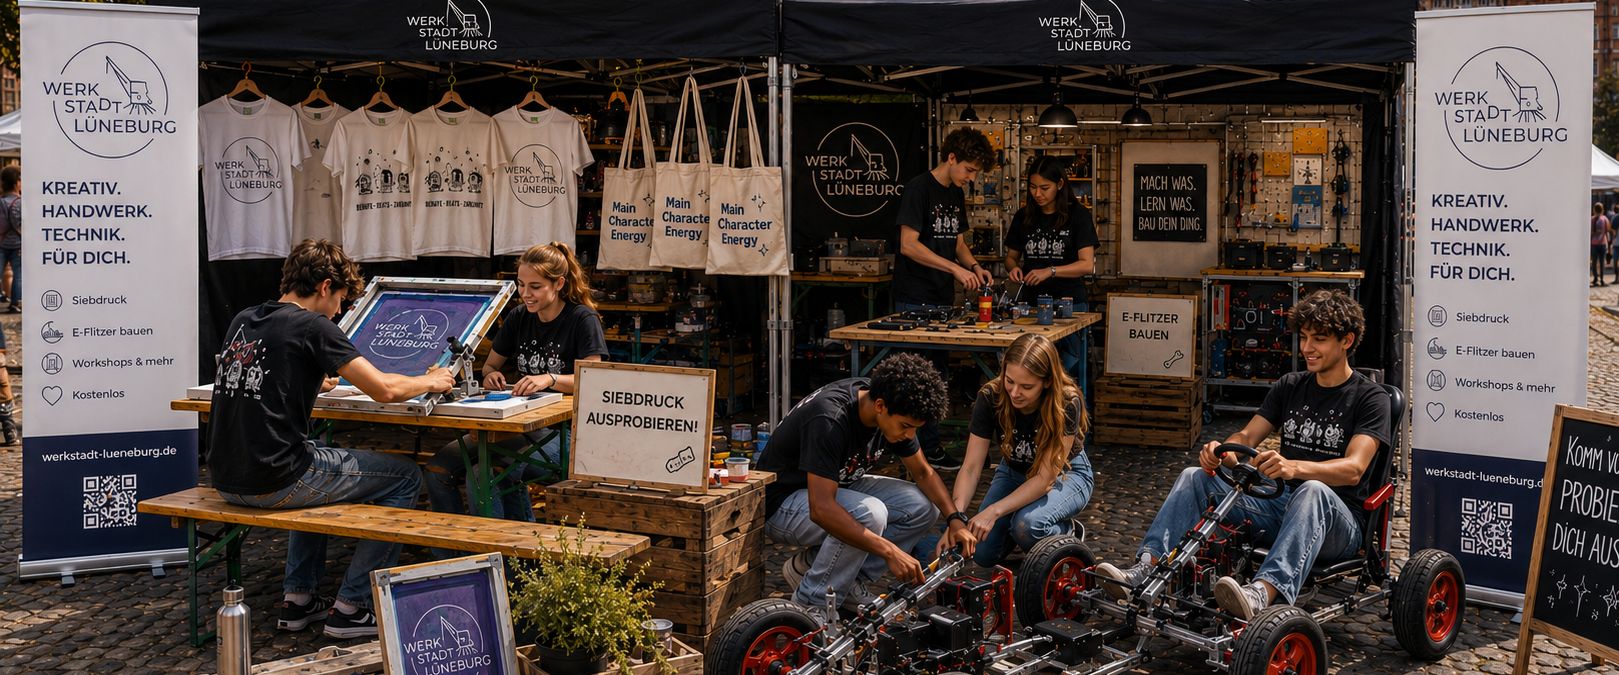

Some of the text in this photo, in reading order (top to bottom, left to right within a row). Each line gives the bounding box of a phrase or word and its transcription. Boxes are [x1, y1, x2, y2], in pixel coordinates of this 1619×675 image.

[406, 16, 445, 26] WERK
[1038, 16, 1078, 27] WERK
[419, 28, 458, 37] STADT
[1051, 28, 1091, 38] STADT
[425, 38, 498, 50] LÜNEBURG
[1057, 39, 1131, 51] LÜNEBURG
[43, 81, 99, 96] WERK
[1435, 91, 1488, 105] WERK
[65, 98, 122, 114] STADT
[1454, 105, 1511, 123] STADT
[74, 116, 176, 134] LÜNEBURG
[1463, 126, 1568, 142] LÜNEBURG
[214, 161, 244, 170] WERK
[805, 155, 847, 167] WERK
[225, 170, 254, 179] STADT
[505, 166, 532, 175] WERK
[820, 169, 863, 180] STADT
[513, 175, 540, 184] STADT
[1140, 175, 1197, 191] MACH WAS.
[42, 181, 121, 195] KREATIV.
[517, 184, 566, 195] LÜNEBURG
[612, 201, 636, 213] Main
[666, 196, 691, 209] Main
[1140, 196, 1195, 212] LERN WAS.
[1432, 194, 1508, 208] KREATIV.
[42, 205, 152, 218] HANDWERK.
[721, 203, 745, 216] Main
[608, 215, 654, 227] Characte
[662, 211, 710, 224] Characte
[718, 217, 772, 230] Character
[1138, 216, 1203, 231] BAU DEIN DING.
[1432, 218, 1539, 232] HANDWERK.
[42, 228, 125, 241] TECHNIK.
[611, 229, 647, 243] Energy
[665, 226, 702, 241] Energy
[721, 233, 758, 248] Energy
[1431, 241, 1510, 257] TECHNIK.
[42, 249, 130, 265] FÜR DICH.
[1430, 262, 1515, 281] FÜR DICH.
[72, 295, 127, 305] Siebdruck
[1122, 312, 1179, 324] E-FLITZER
[1456, 312, 1509, 324] Siebdruck
[72, 326, 153, 337] E-Flitzer bauen
[1129, 329, 1169, 340] BAUEN
[1456, 345, 1535, 359] E-Flitzer bauen
[72, 356, 174, 369] Workshops & mehr
[1455, 377, 1556, 394] Workshops & mehr
[72, 389, 125, 400] Kostenlos
[602, 390, 685, 409] SIEBDRUCK
[586, 411, 698, 433] AUSPROBIEREN!
[1454, 409, 1504, 422] Kostenlos
[42, 446, 177, 463] werkstadt-lueneburg.de
[1424, 467, 1544, 489] werkstadt-lueneburg.d
[1588, 533, 1619, 568] AUS
[403, 637, 442, 654] WERK
[417, 648, 454, 665] STADT
[425, 654, 491, 675] LÜNEBURG
